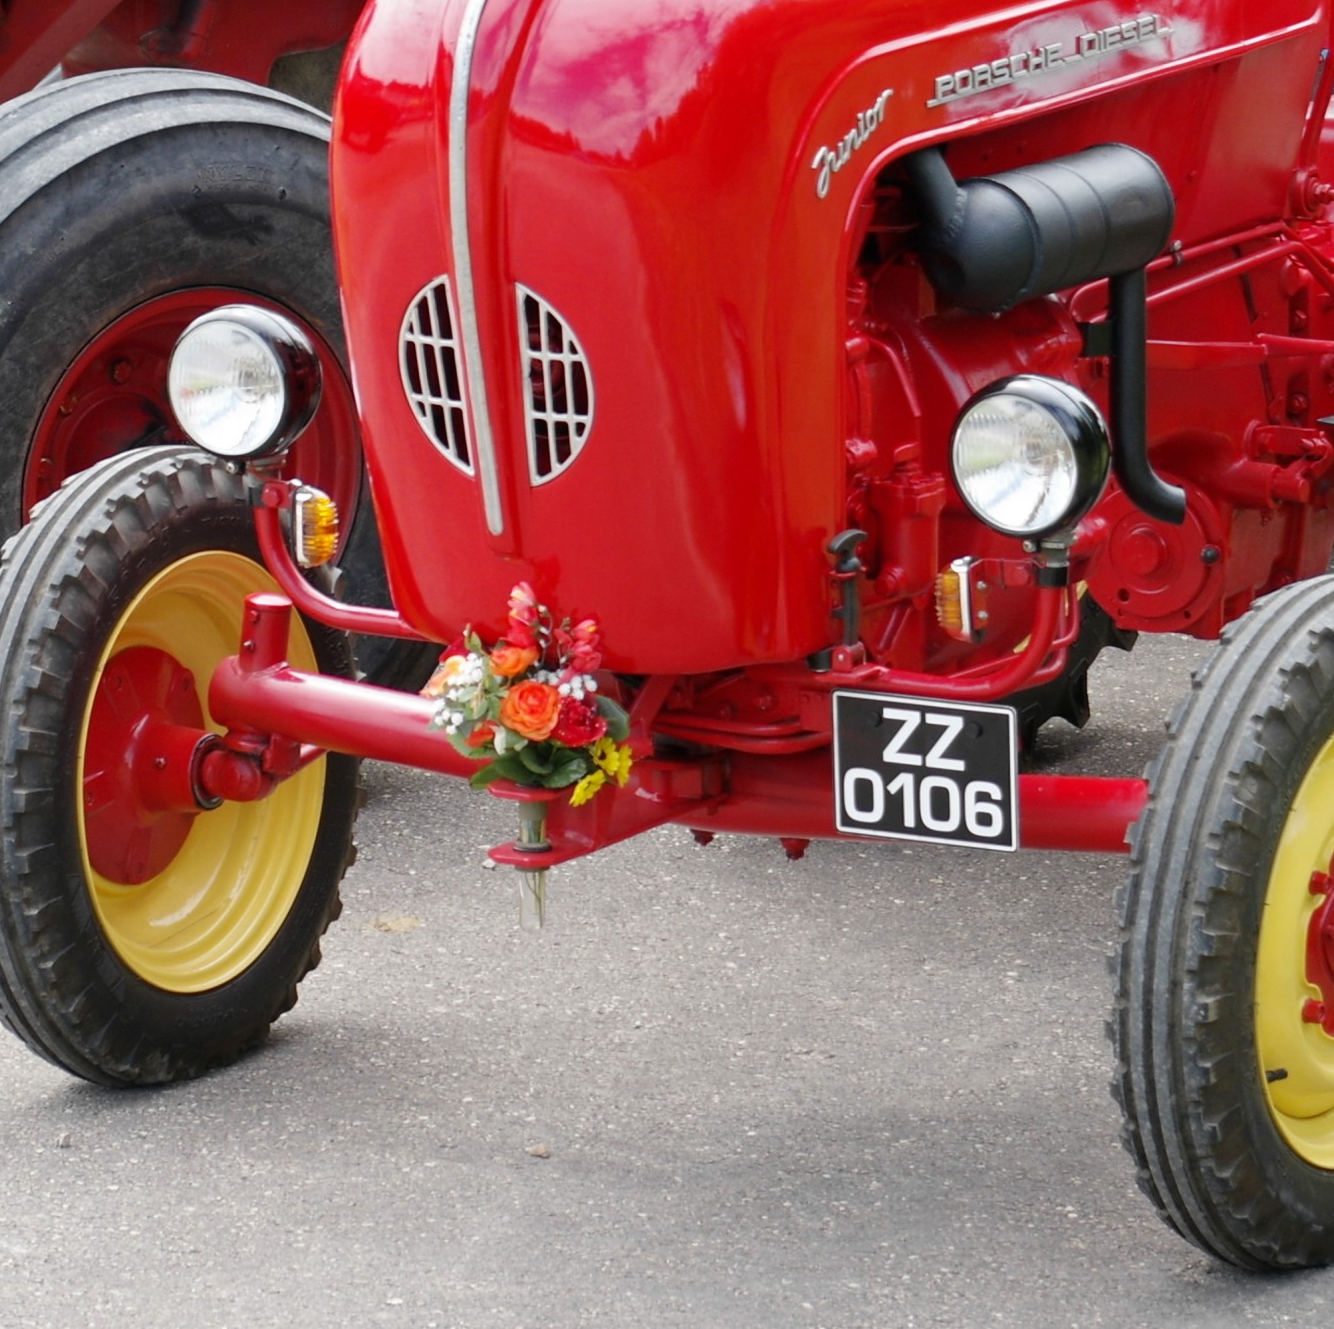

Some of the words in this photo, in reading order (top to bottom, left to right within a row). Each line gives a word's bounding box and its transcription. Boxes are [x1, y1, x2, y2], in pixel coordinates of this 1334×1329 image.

[929, 43, 1064, 107] PORSCHE
[1078, 15, 1173, 58] DIESEL
[811, 88, 895, 199] Junior
[882, 707, 965, 771] ZZ
[843, 767, 1003, 838] 0106
